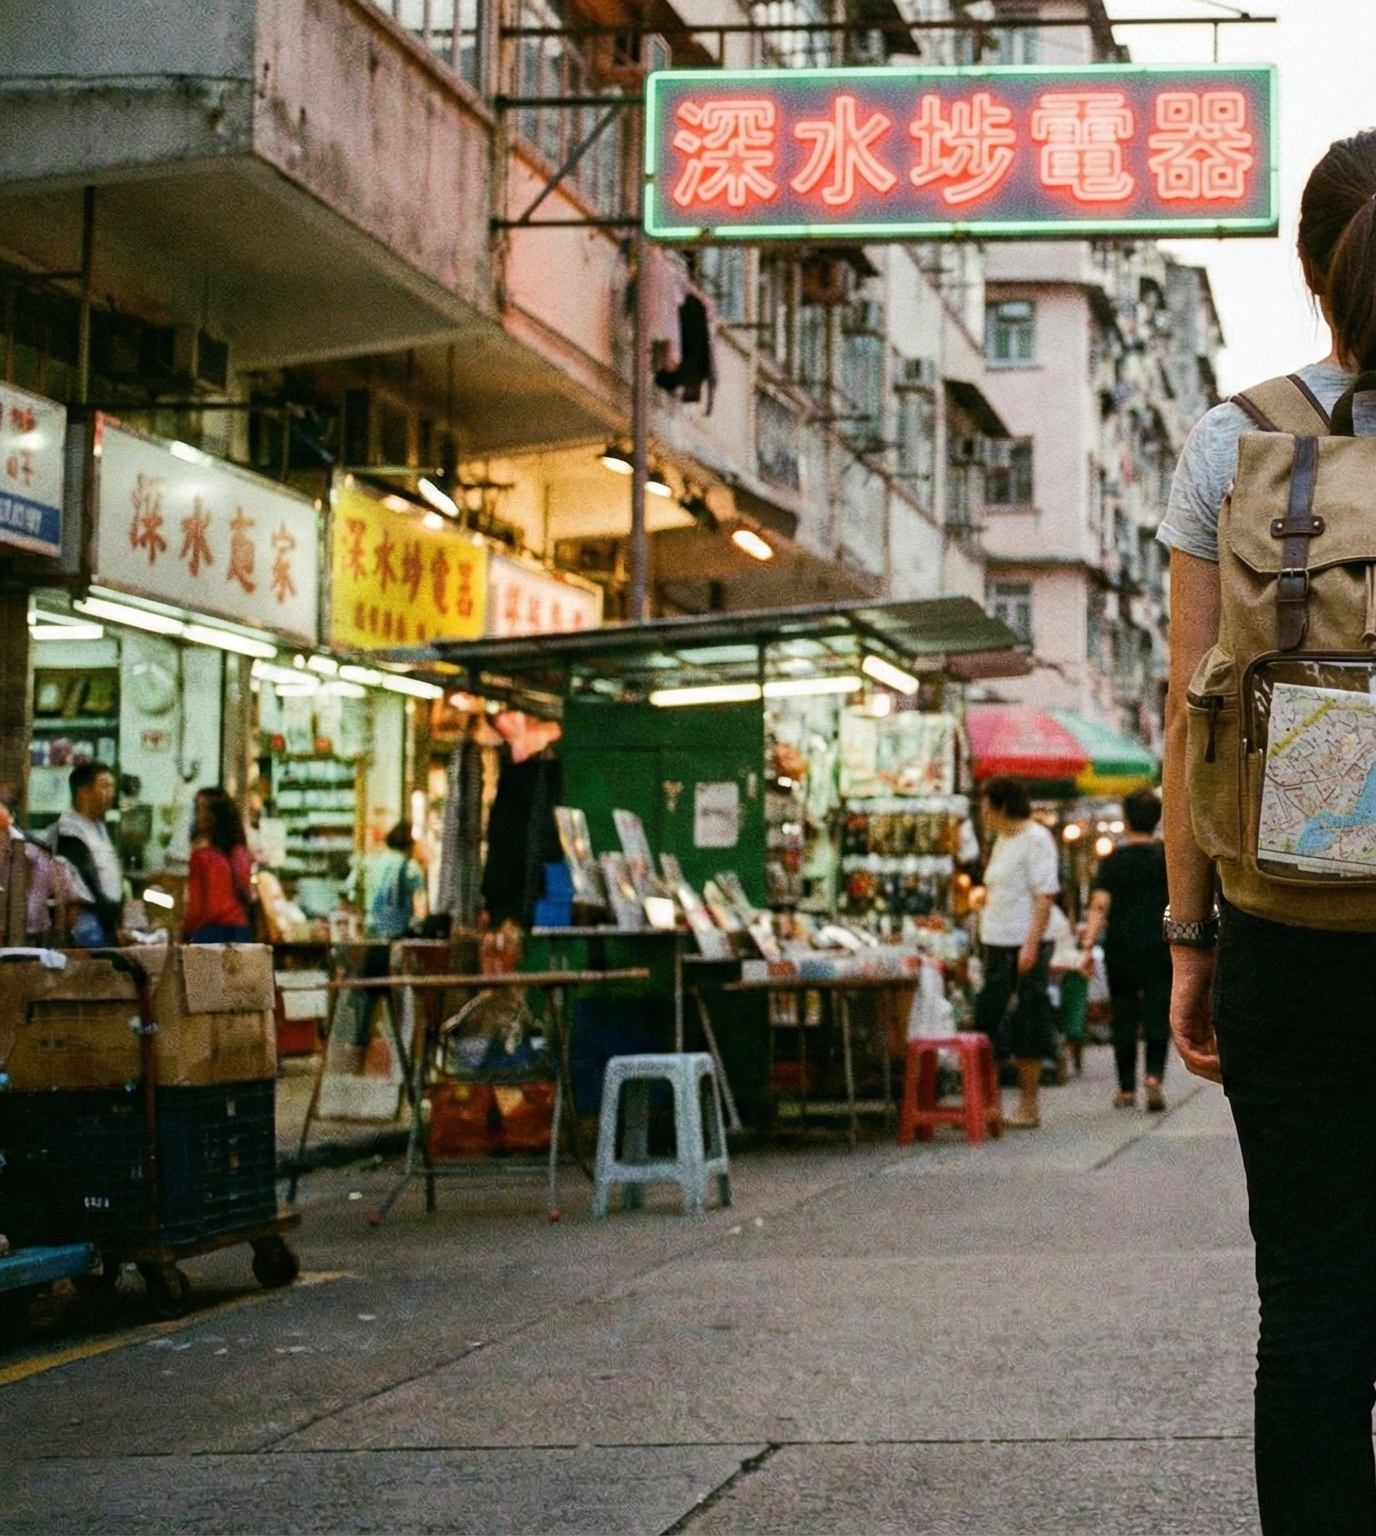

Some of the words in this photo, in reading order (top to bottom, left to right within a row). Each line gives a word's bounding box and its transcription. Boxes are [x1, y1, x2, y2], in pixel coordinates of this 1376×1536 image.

[673, 91, 1252, 206] 深水埗電器
